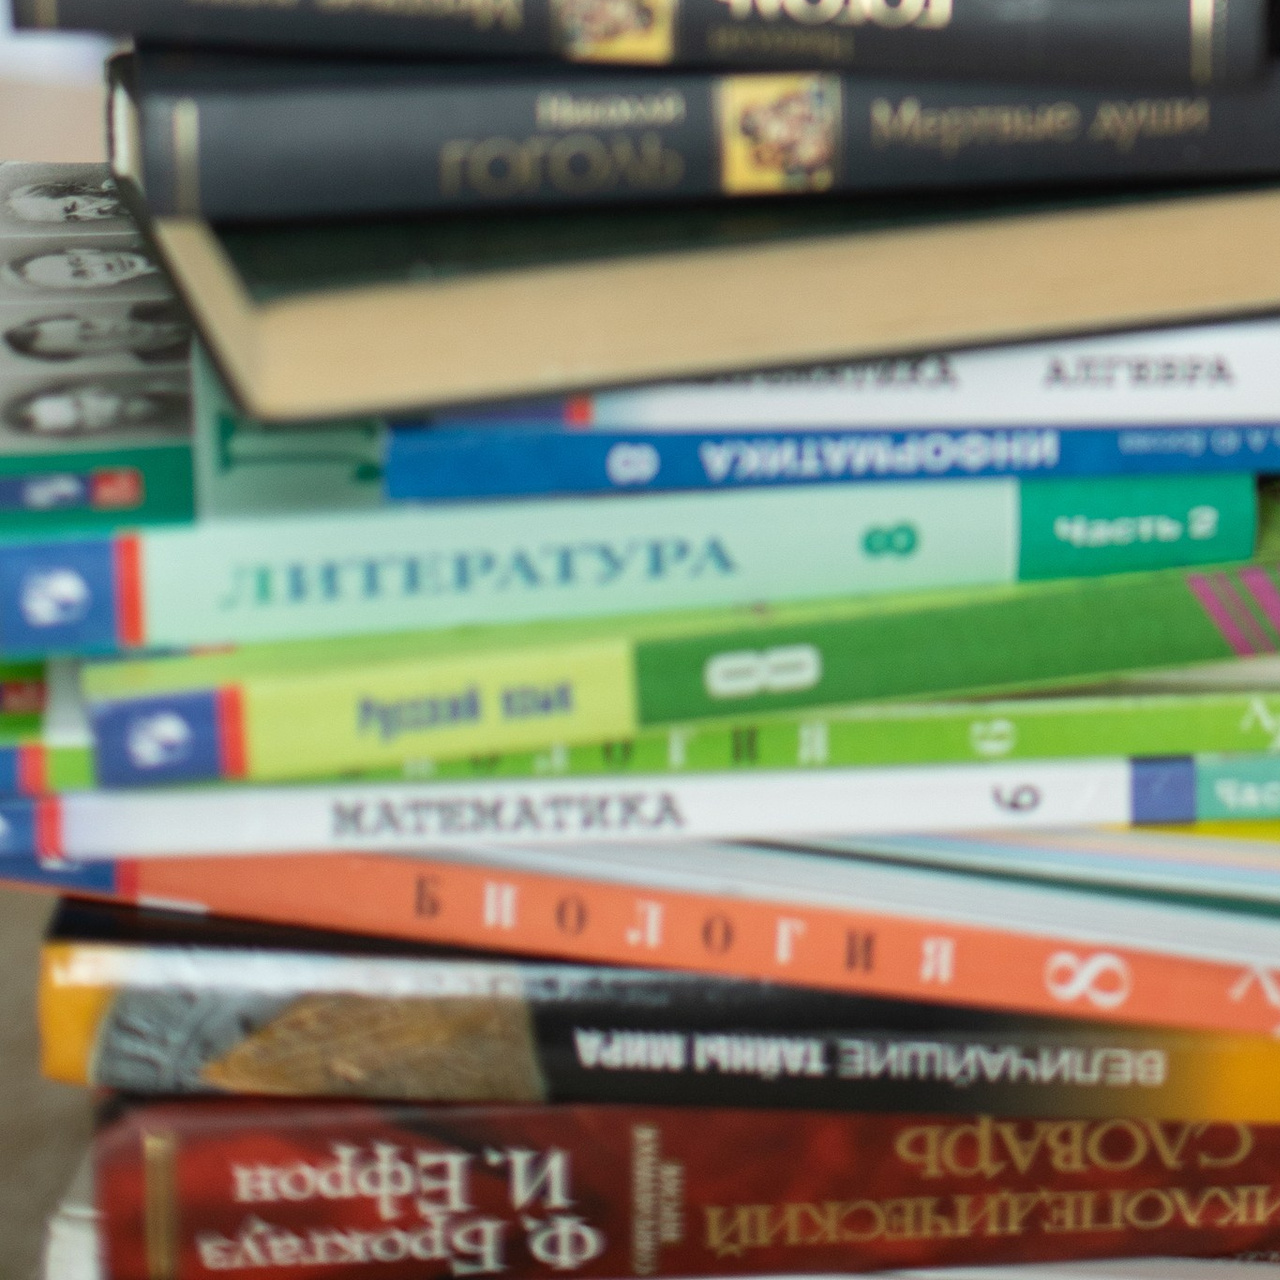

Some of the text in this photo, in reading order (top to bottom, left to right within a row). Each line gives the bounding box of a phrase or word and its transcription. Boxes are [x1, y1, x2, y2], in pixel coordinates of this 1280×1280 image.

[440, 134, 685, 197] ГОГОЛЬ
[1044, 355, 1233, 390] АЛГЕБРА
[700, 430, 1059, 482] ИНФОРМАТИКА
[220, 505, 1220, 610] ЛИТЕРАТУРА 8 Часть 2
[357, 642, 822, 744] Русский язык 8
[330, 791, 686, 840] МАТЕМАТИКА
[414, 874, 955, 984] БИОЛОГИЯ
[1044, 949, 1132, 1009] 8
[573, 1027, 1169, 1088] ВЕЛИЧАЙШИЕ ТАЙНЫ МИРА
[484, 1145, 576, 1211] И.
[895, 1114, 1254, 1180] СЛОВАРЬ
[232, 1143, 472, 1221] Ефрон
[196, 1212, 607, 1277] Ф. Брокгауз
